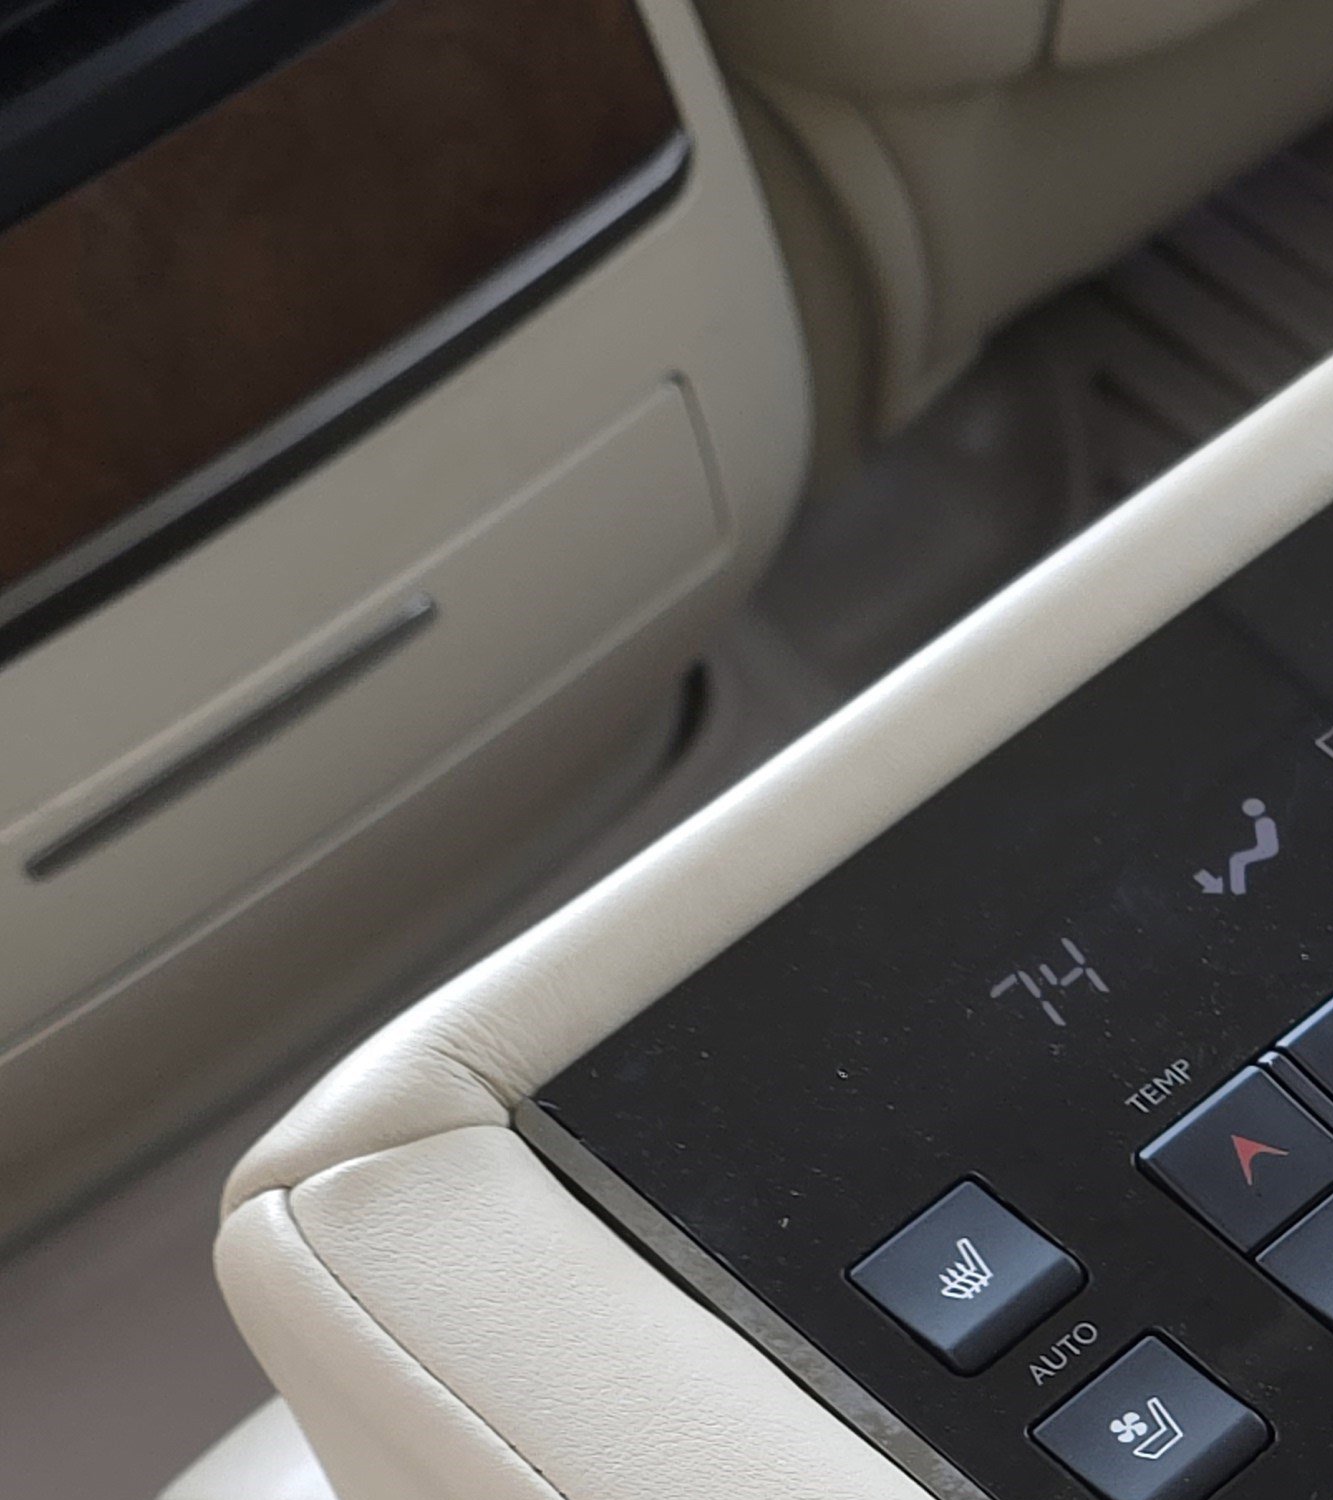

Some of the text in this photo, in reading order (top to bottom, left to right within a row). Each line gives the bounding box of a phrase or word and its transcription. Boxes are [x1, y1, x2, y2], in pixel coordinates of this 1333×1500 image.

[990, 936, 1109, 1026] 74
[1125, 1057, 1194, 1116] TEMP
[1027, 1320, 1099, 1386] AUTO
